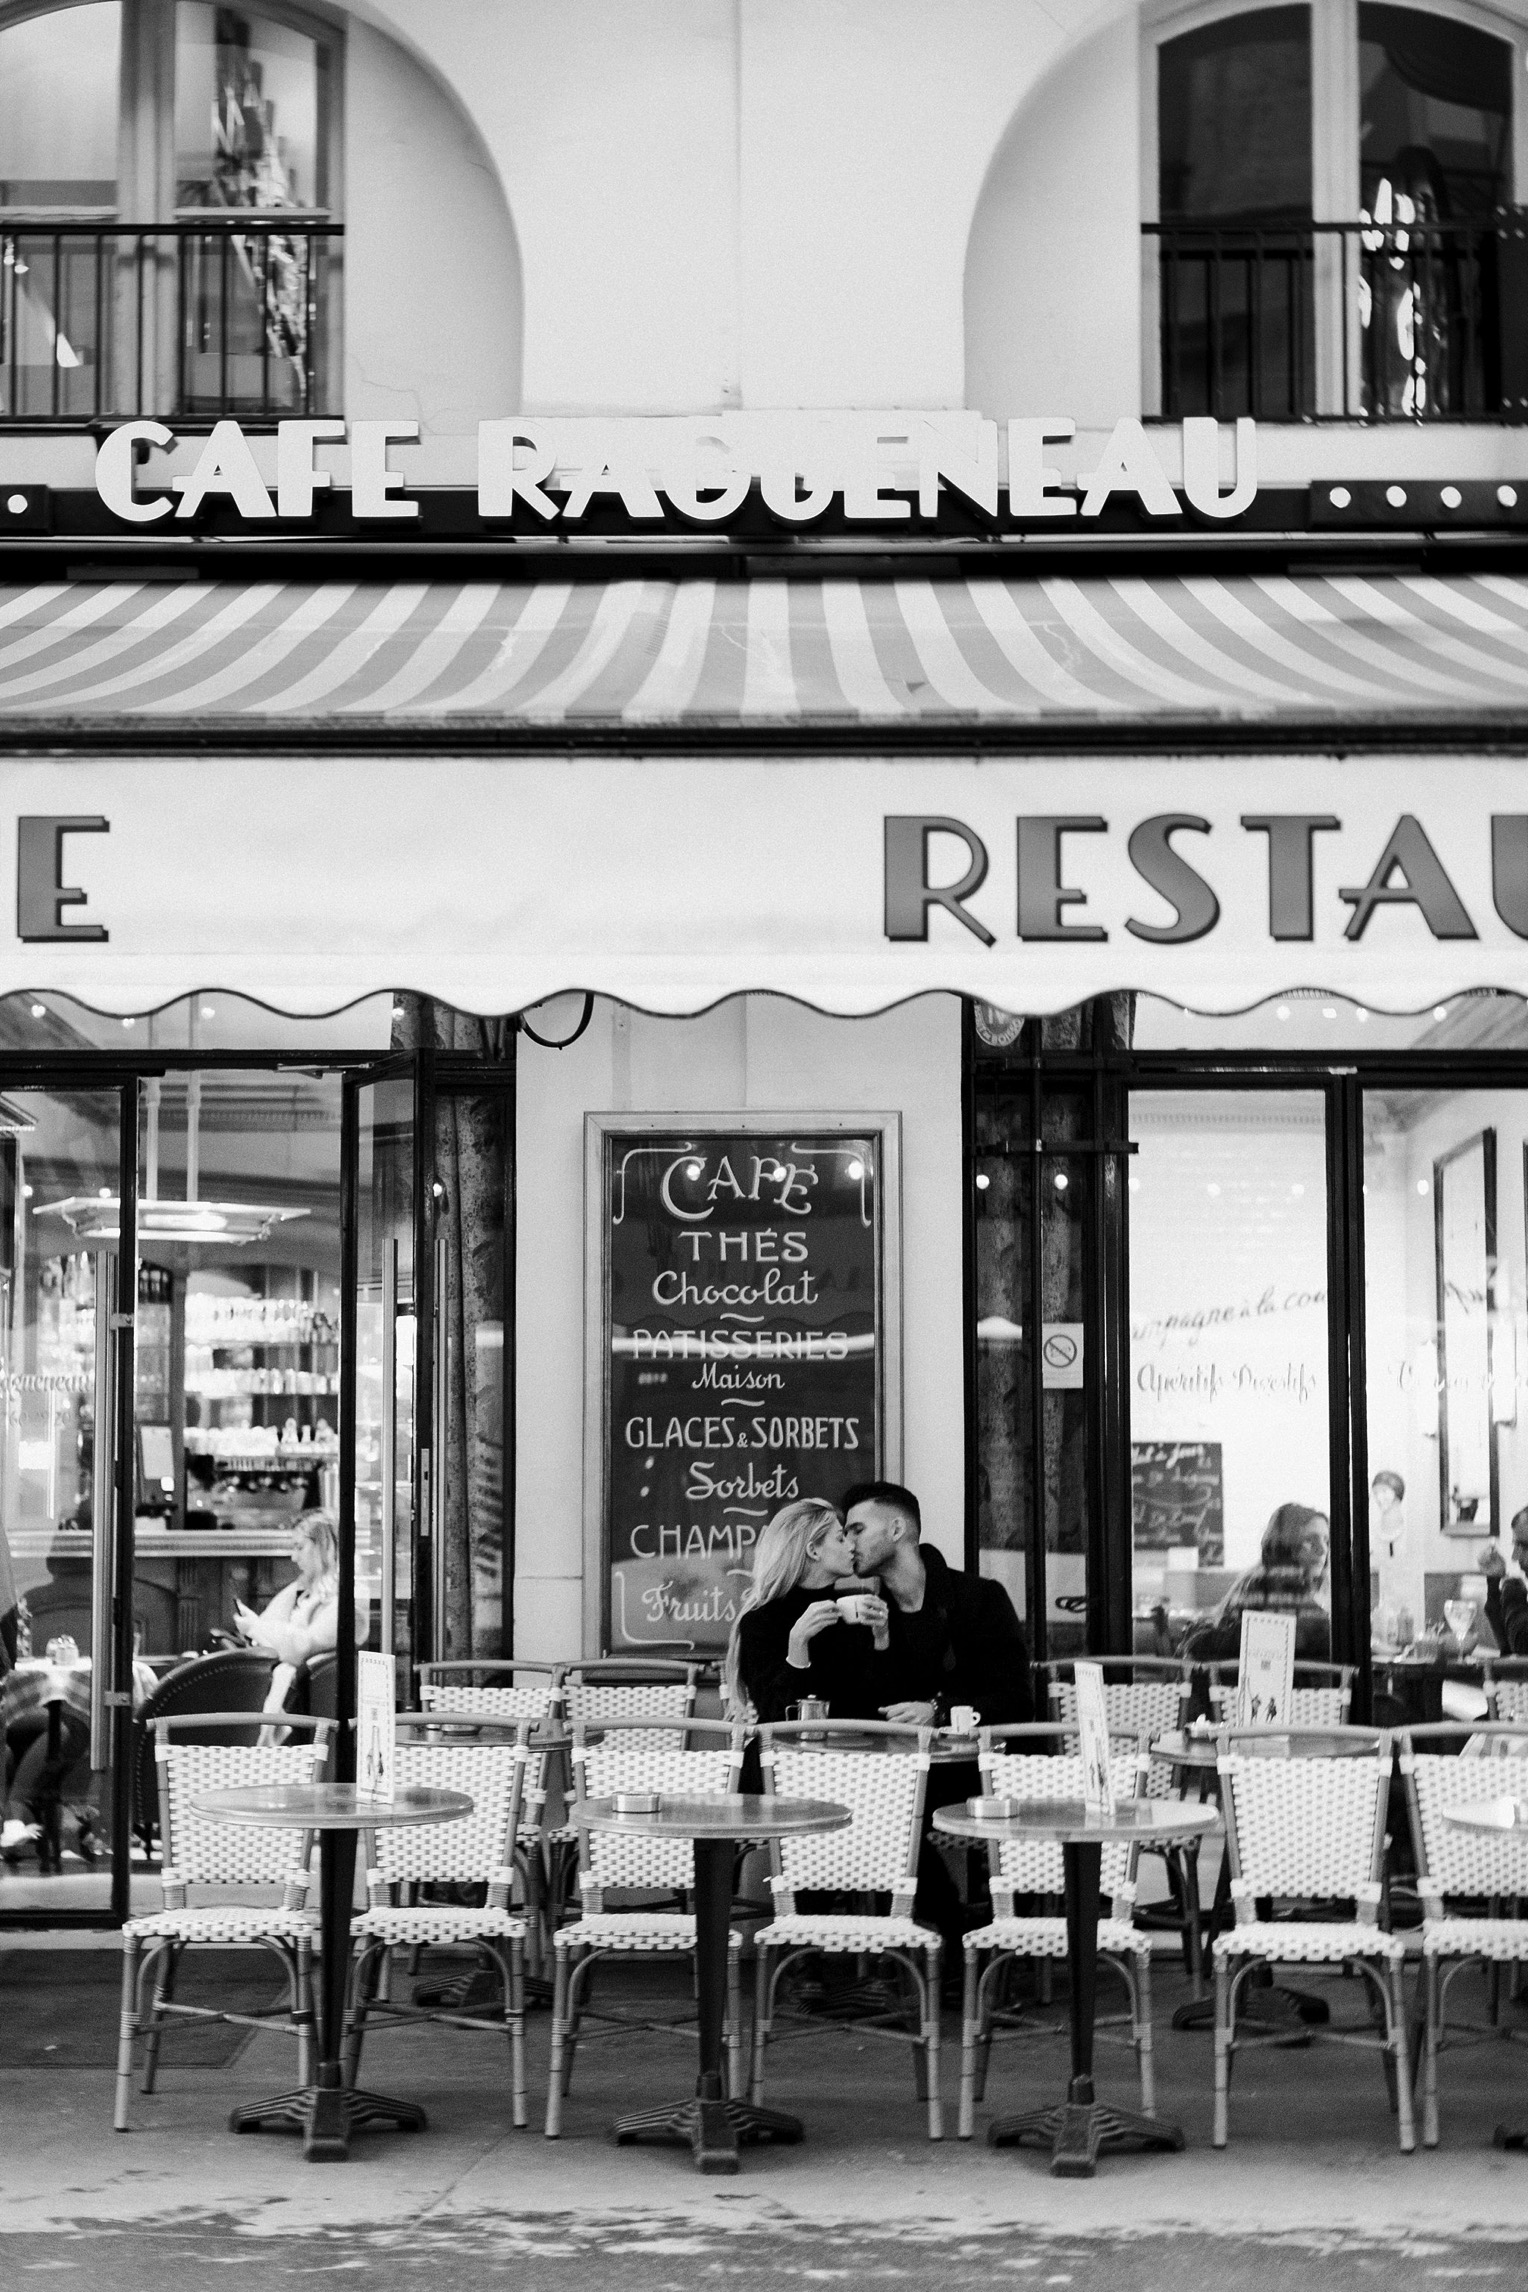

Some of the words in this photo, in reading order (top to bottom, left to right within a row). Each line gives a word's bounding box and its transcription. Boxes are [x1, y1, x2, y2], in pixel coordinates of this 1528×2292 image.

[95, 419, 422, 522] CAFE
[478, 415, 1258, 522] RAGUENEAU
[678, 1227, 809, 1262] THÉS
[652, 1267, 819, 1305] Chocolat
[632, 1328, 849, 1360] PATISSERIES
[691, 1361, 785, 1389] Maison
[685, 1461, 799, 1499] Sorbets
[630, 1524, 768, 1559] CHAMP
[641, 1580, 736, 1621] Fruits
